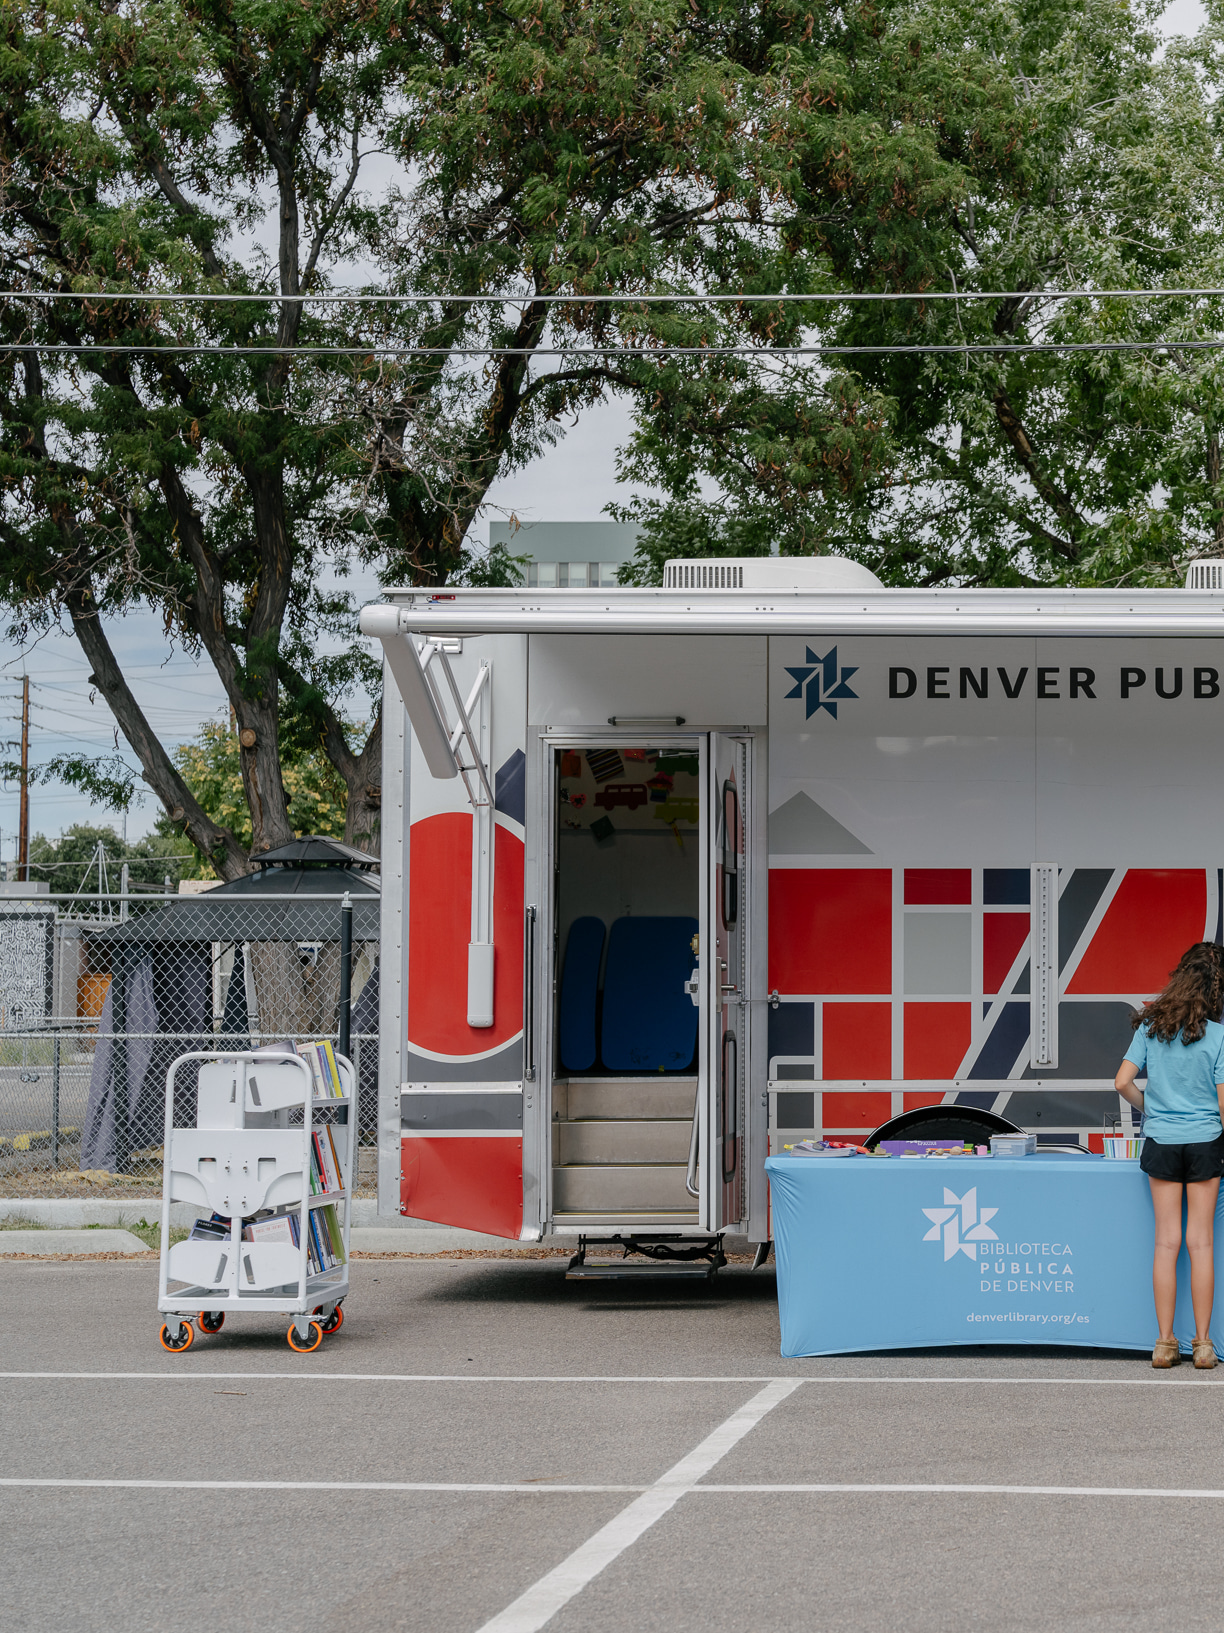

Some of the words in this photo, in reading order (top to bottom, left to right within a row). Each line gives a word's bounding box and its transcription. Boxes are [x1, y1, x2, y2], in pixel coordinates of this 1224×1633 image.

[888, 666, 1098, 700] DENVER
[980, 1242, 1073, 1256] BIBLIOTECA
[980, 1258, 1074, 1275] PÚBLICA
[980, 1280, 1002, 1292] DE
[1007, 1280, 1075, 1293] DENVER
[966, 1311, 1090, 1325] denverlibrary.org/es
